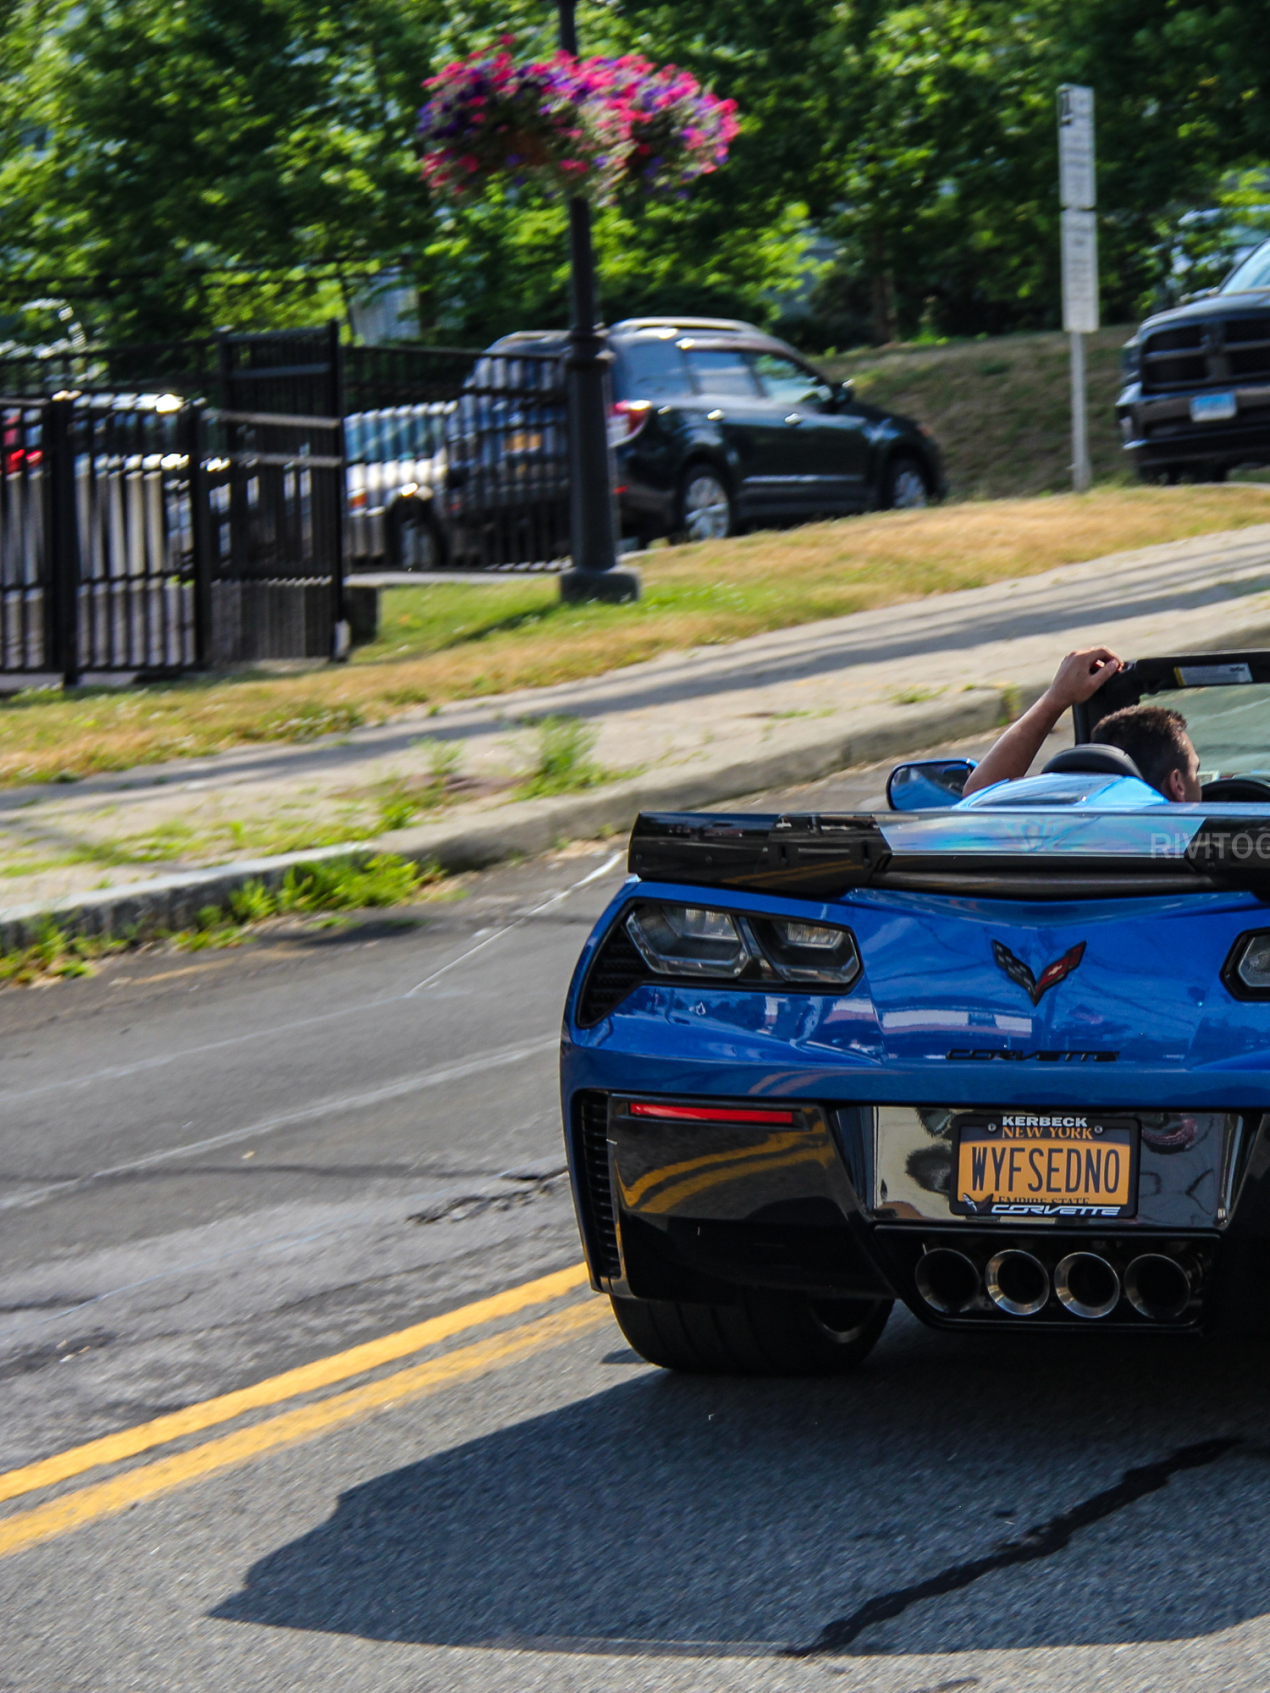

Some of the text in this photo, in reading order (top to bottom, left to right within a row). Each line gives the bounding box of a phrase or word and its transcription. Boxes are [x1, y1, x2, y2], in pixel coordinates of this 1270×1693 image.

[945, 1049, 1120, 1062] CORVETTE
[1002, 1116, 1088, 1127] KERBECK
[1002, 1127, 1093, 1139] NEW YORK
[971, 1146, 1120, 1194] WYFSEDNO
[991, 1204, 1121, 1216] CORVETTE
